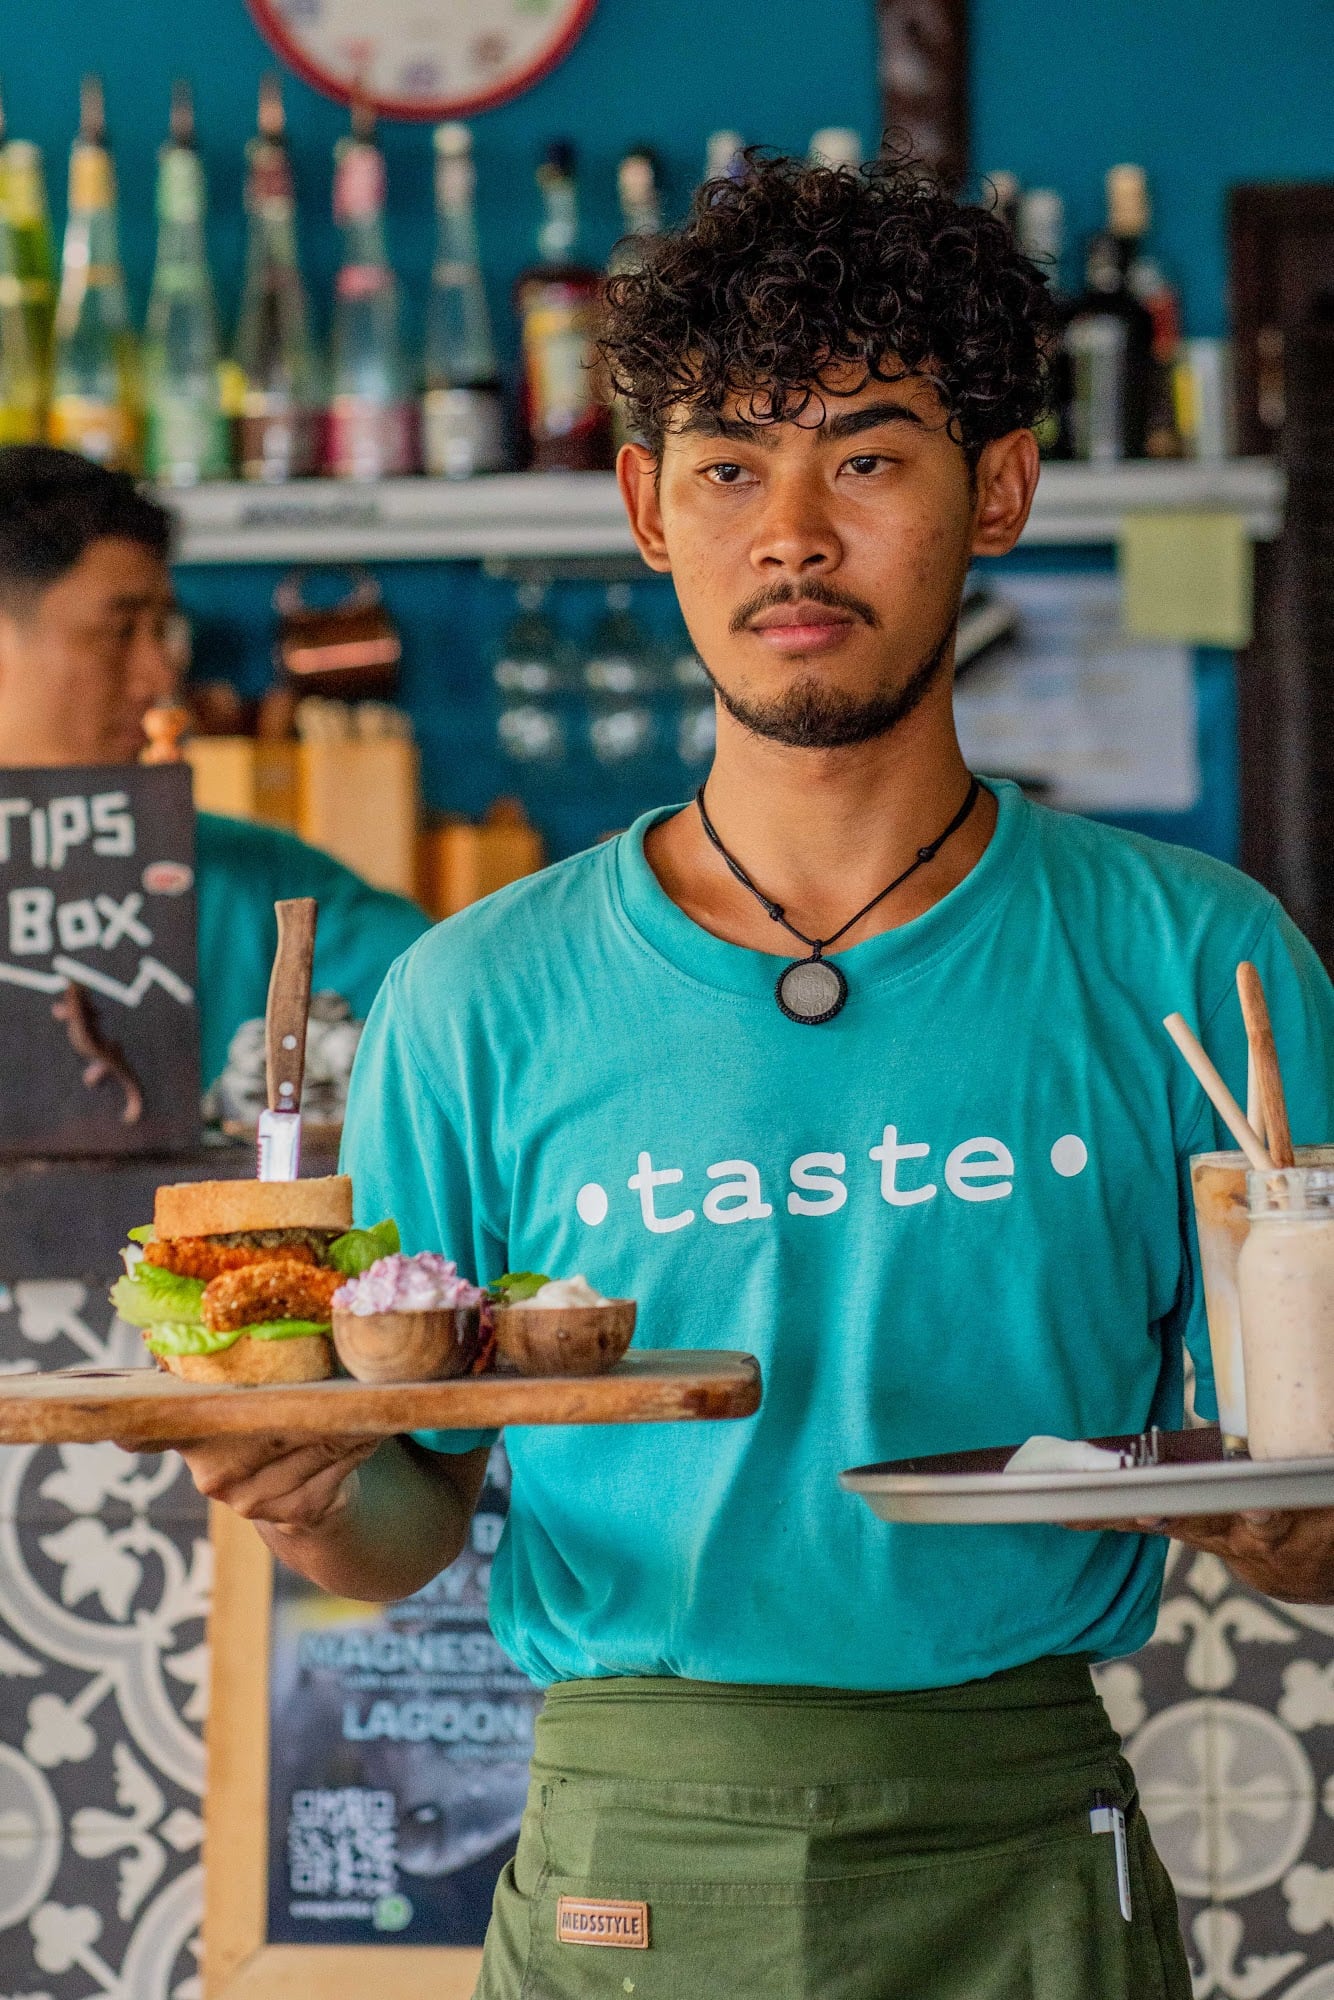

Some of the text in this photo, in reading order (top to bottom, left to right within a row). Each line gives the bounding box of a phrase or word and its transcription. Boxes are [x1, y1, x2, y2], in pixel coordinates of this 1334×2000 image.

[627, 1123, 1015, 1234] taste
[342, 1700, 533, 1742] LAGOON
[562, 1912, 640, 1935] MEDSSTYLE
